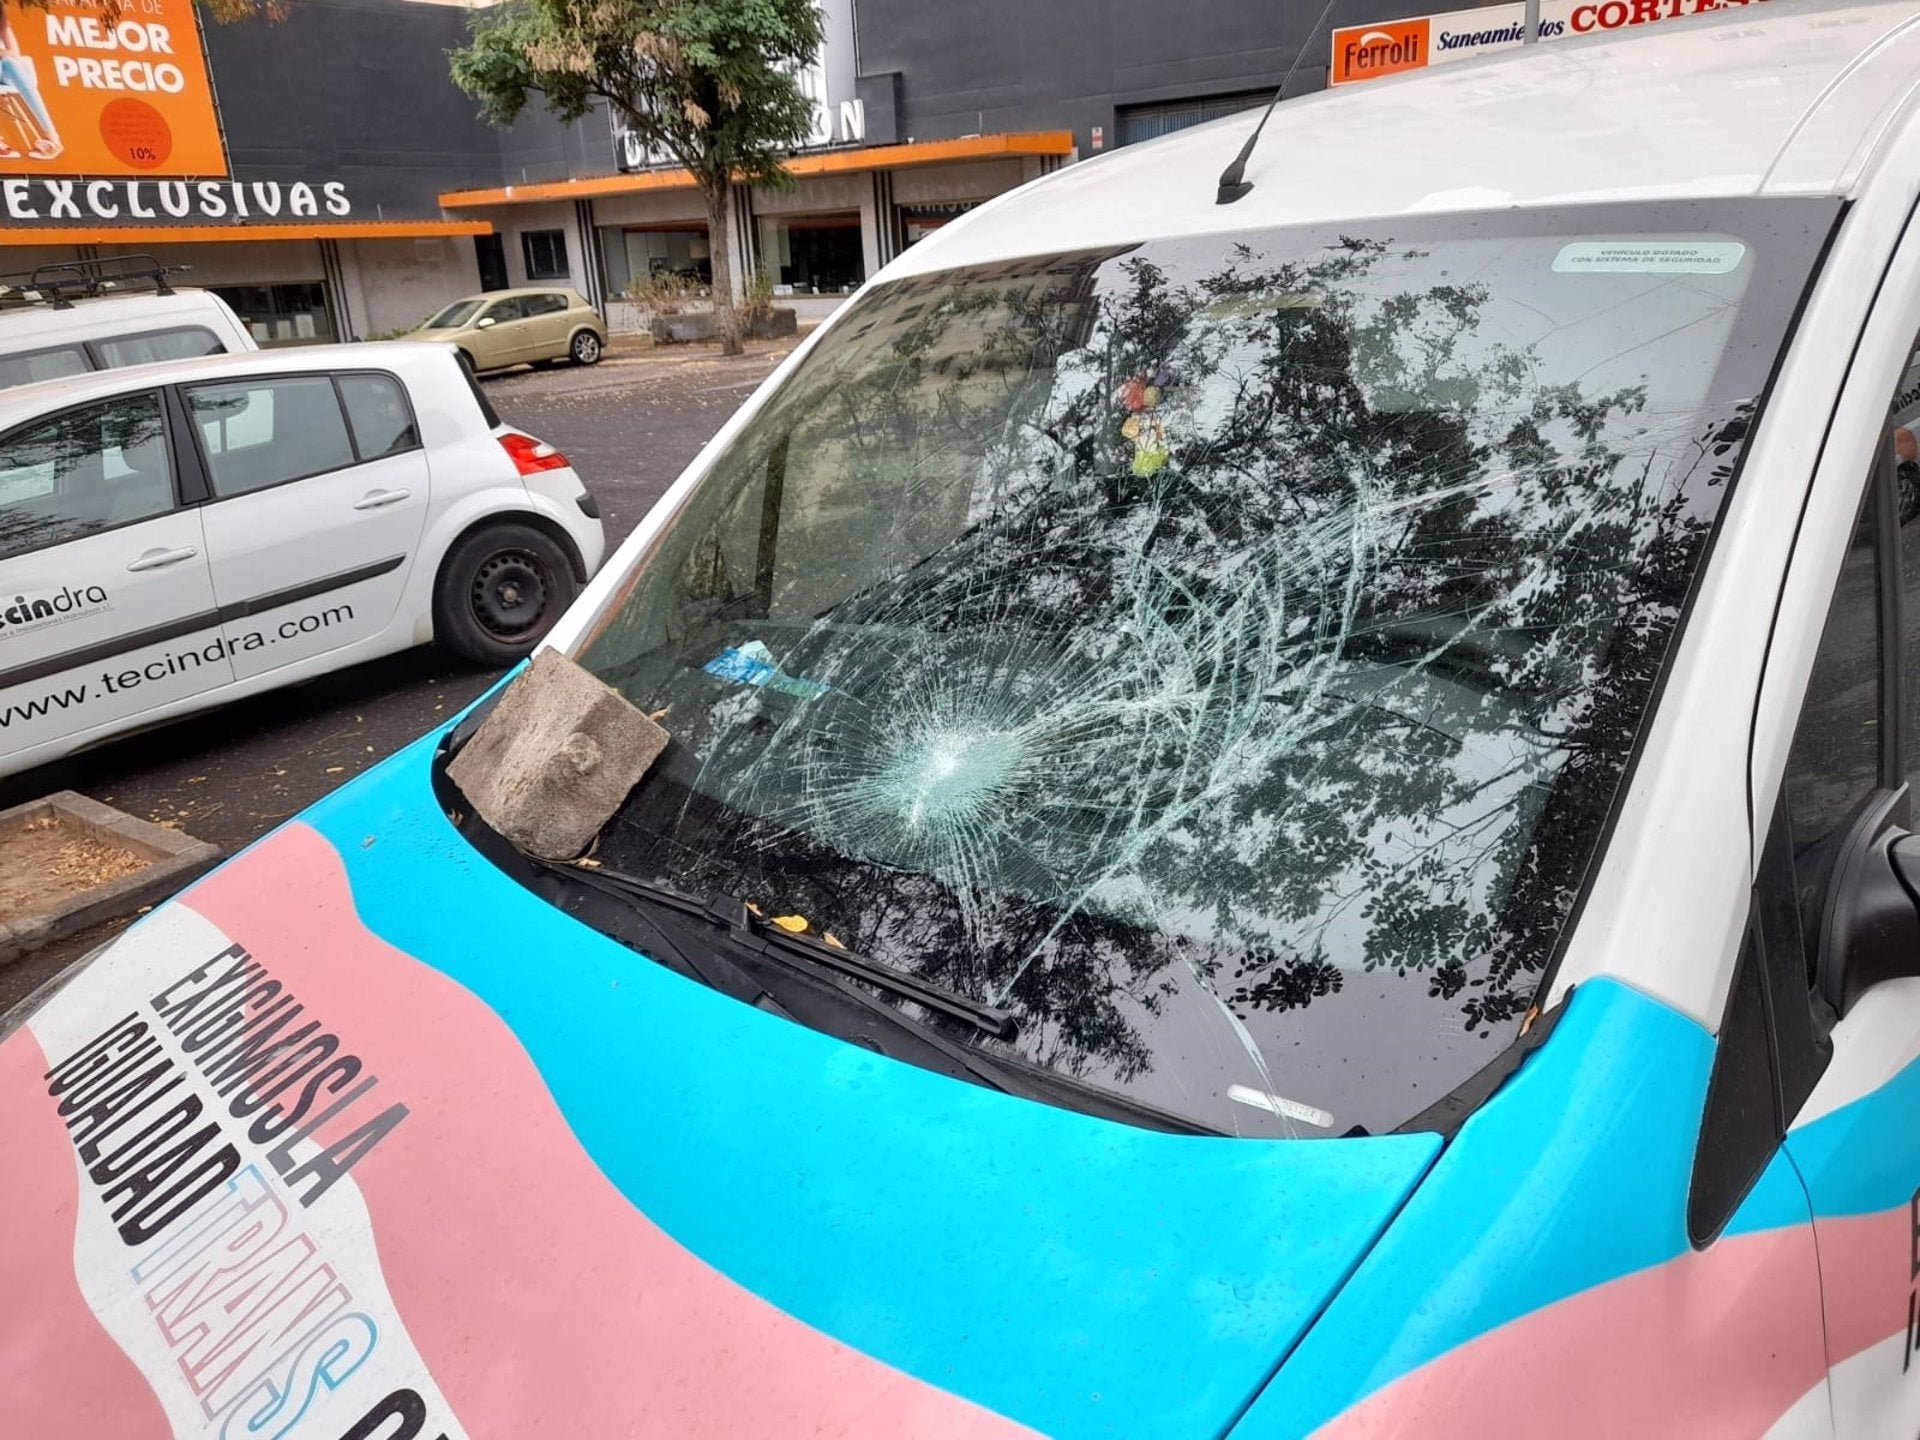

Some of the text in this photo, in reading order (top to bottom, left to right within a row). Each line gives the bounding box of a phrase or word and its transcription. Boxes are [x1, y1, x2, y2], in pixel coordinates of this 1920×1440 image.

[45, 14, 174, 54] MEJOR
[1436, 20, 1565, 51] Saneamietos
[1344, 32, 1418, 78] Ferroli
[53, 56, 185, 94] PRECIO
[129, 147, 156, 160] 10%
[3, 179, 350, 218] EXCLUSIVAS
